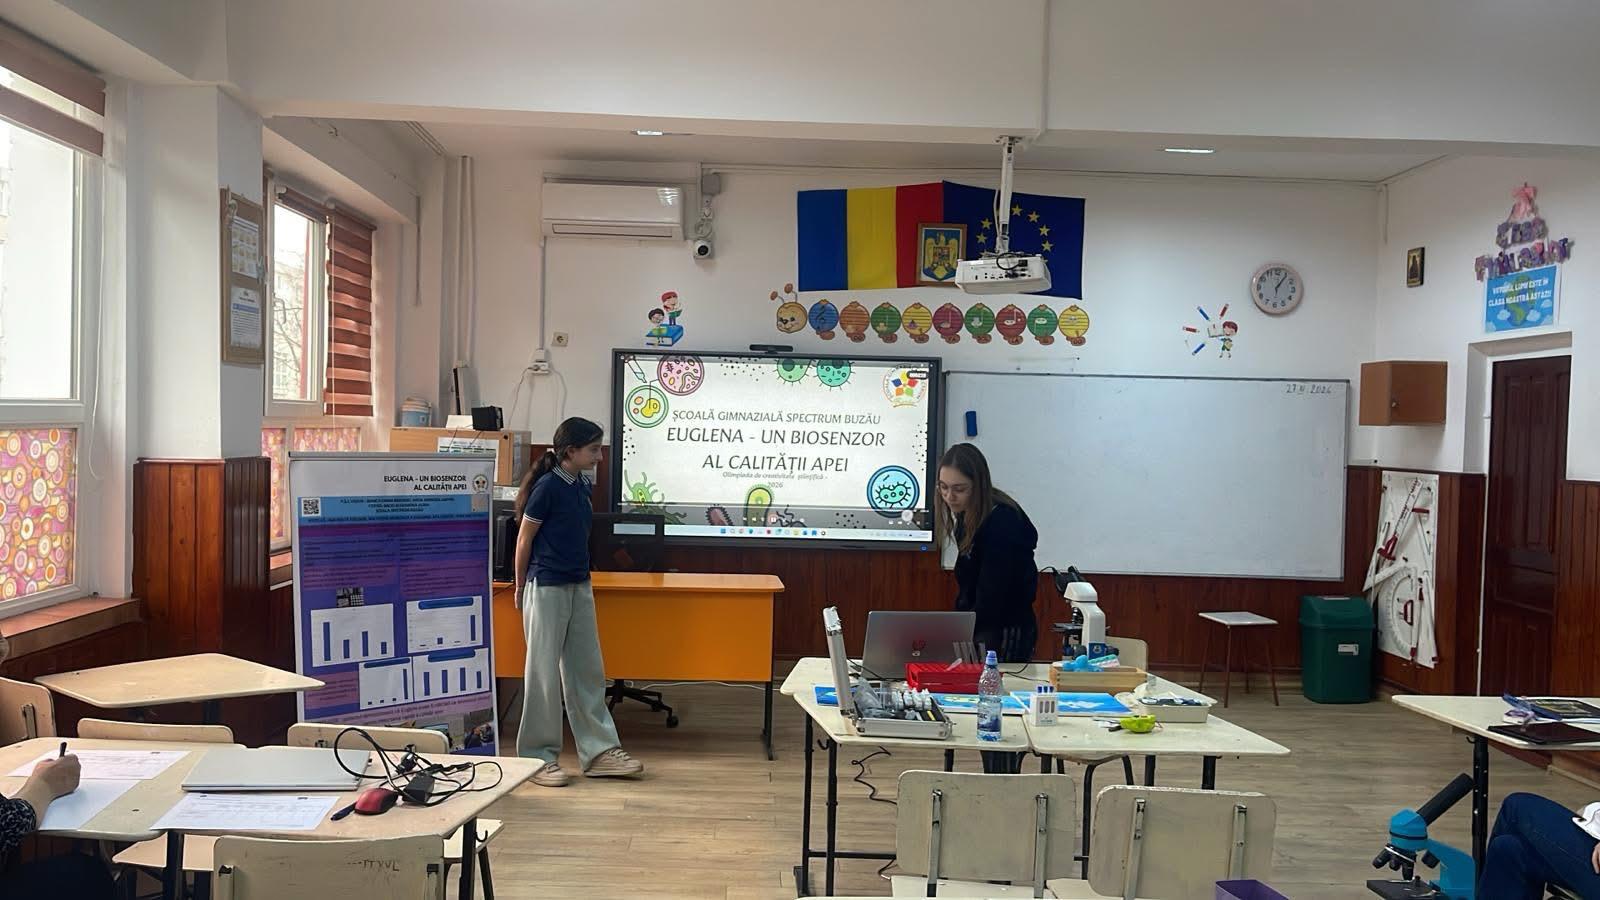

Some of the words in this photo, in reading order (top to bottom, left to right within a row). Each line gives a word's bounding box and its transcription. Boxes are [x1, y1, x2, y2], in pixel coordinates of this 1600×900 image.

[717, 411, 783, 422] GIMNAZIALĂ
[786, 413, 842, 424] SPECTRUM
[844, 413, 881, 425] BUZĂU
[667, 427, 744, 443] EUGLENA
[761, 429, 786, 444] UN
[790, 430, 886, 447] BIOSENZOR
[702, 454, 724, 469] AL
[811, 456, 849, 472] APEI
[384, 475, 414, 483] EUGLENA
